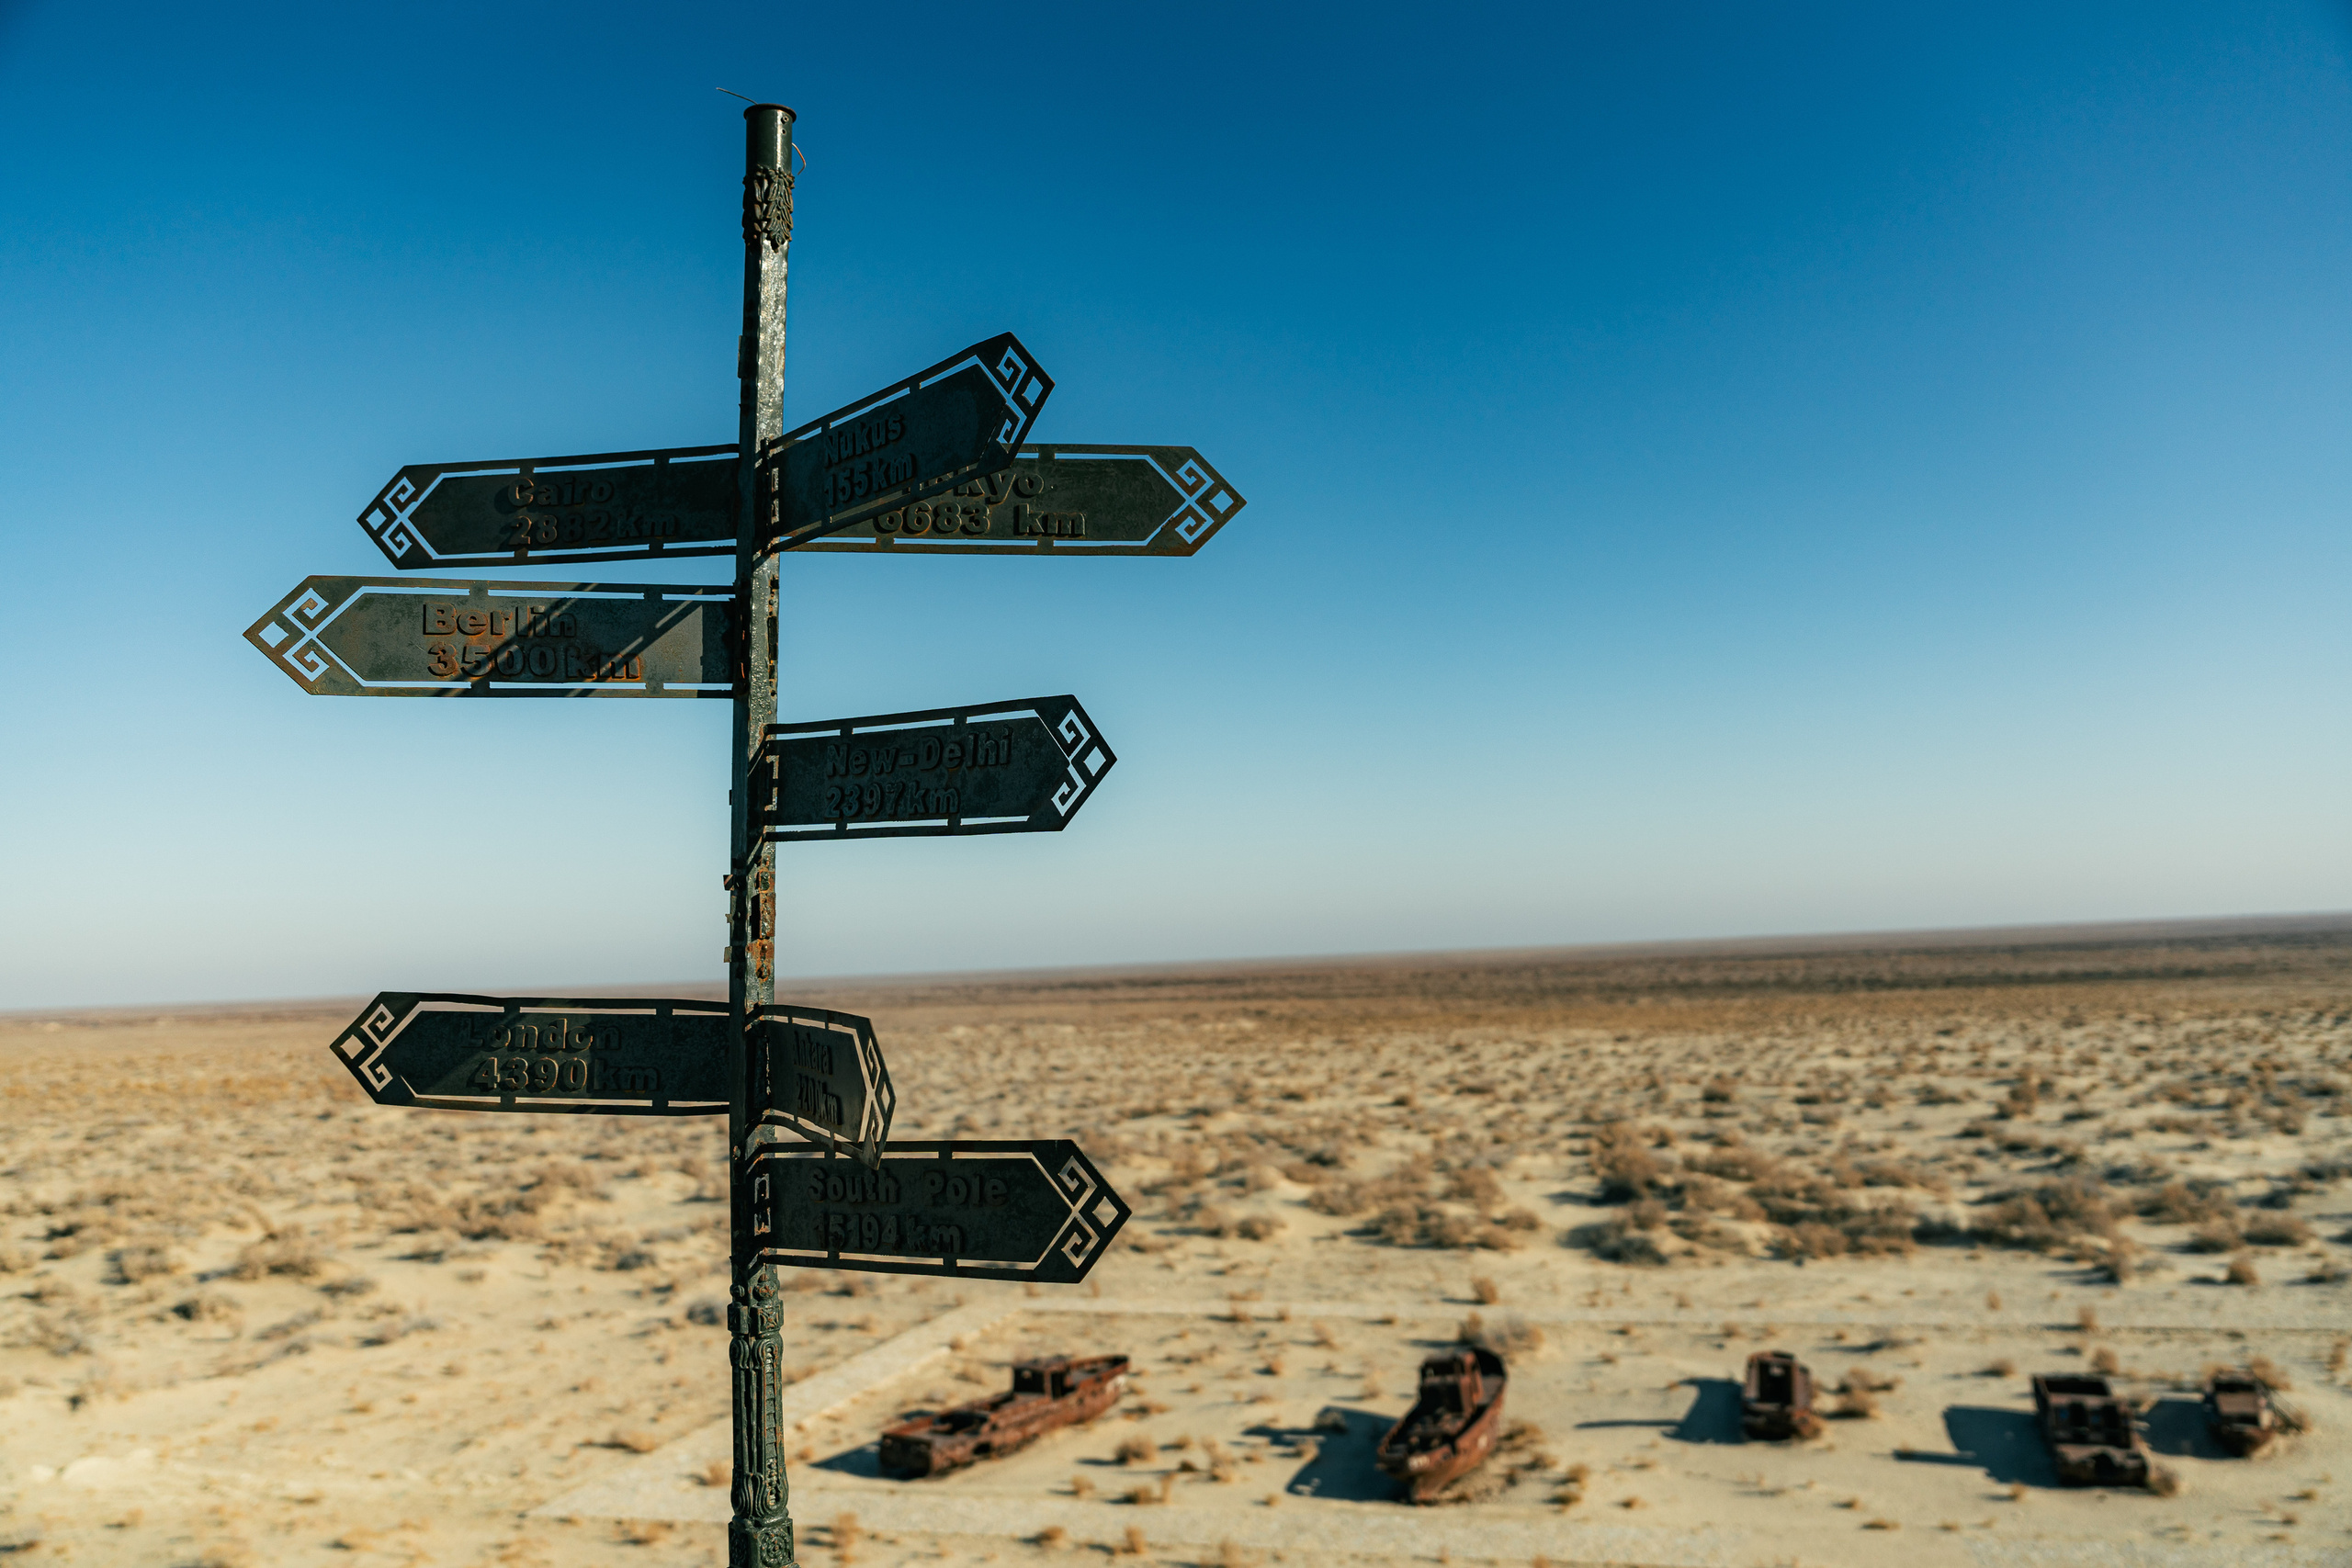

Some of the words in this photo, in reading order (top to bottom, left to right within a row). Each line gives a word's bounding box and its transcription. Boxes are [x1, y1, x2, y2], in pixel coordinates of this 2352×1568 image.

[824, 413, 904, 468] Nukus
[506, 477, 615, 508] Cairo
[919, 464, 1042, 504] kyo
[1013, 503, 1086, 536] km
[423, 602, 577, 637] Berlin
[826, 724, 1013, 778] New-Delhi
[824, 781, 960, 819] 2397km
[460, 1017, 621, 1051] London
[793, 1031, 833, 1076] Ankara
[808, 1167, 900, 1203] South
[922, 1168, 1009, 1207] Pole
